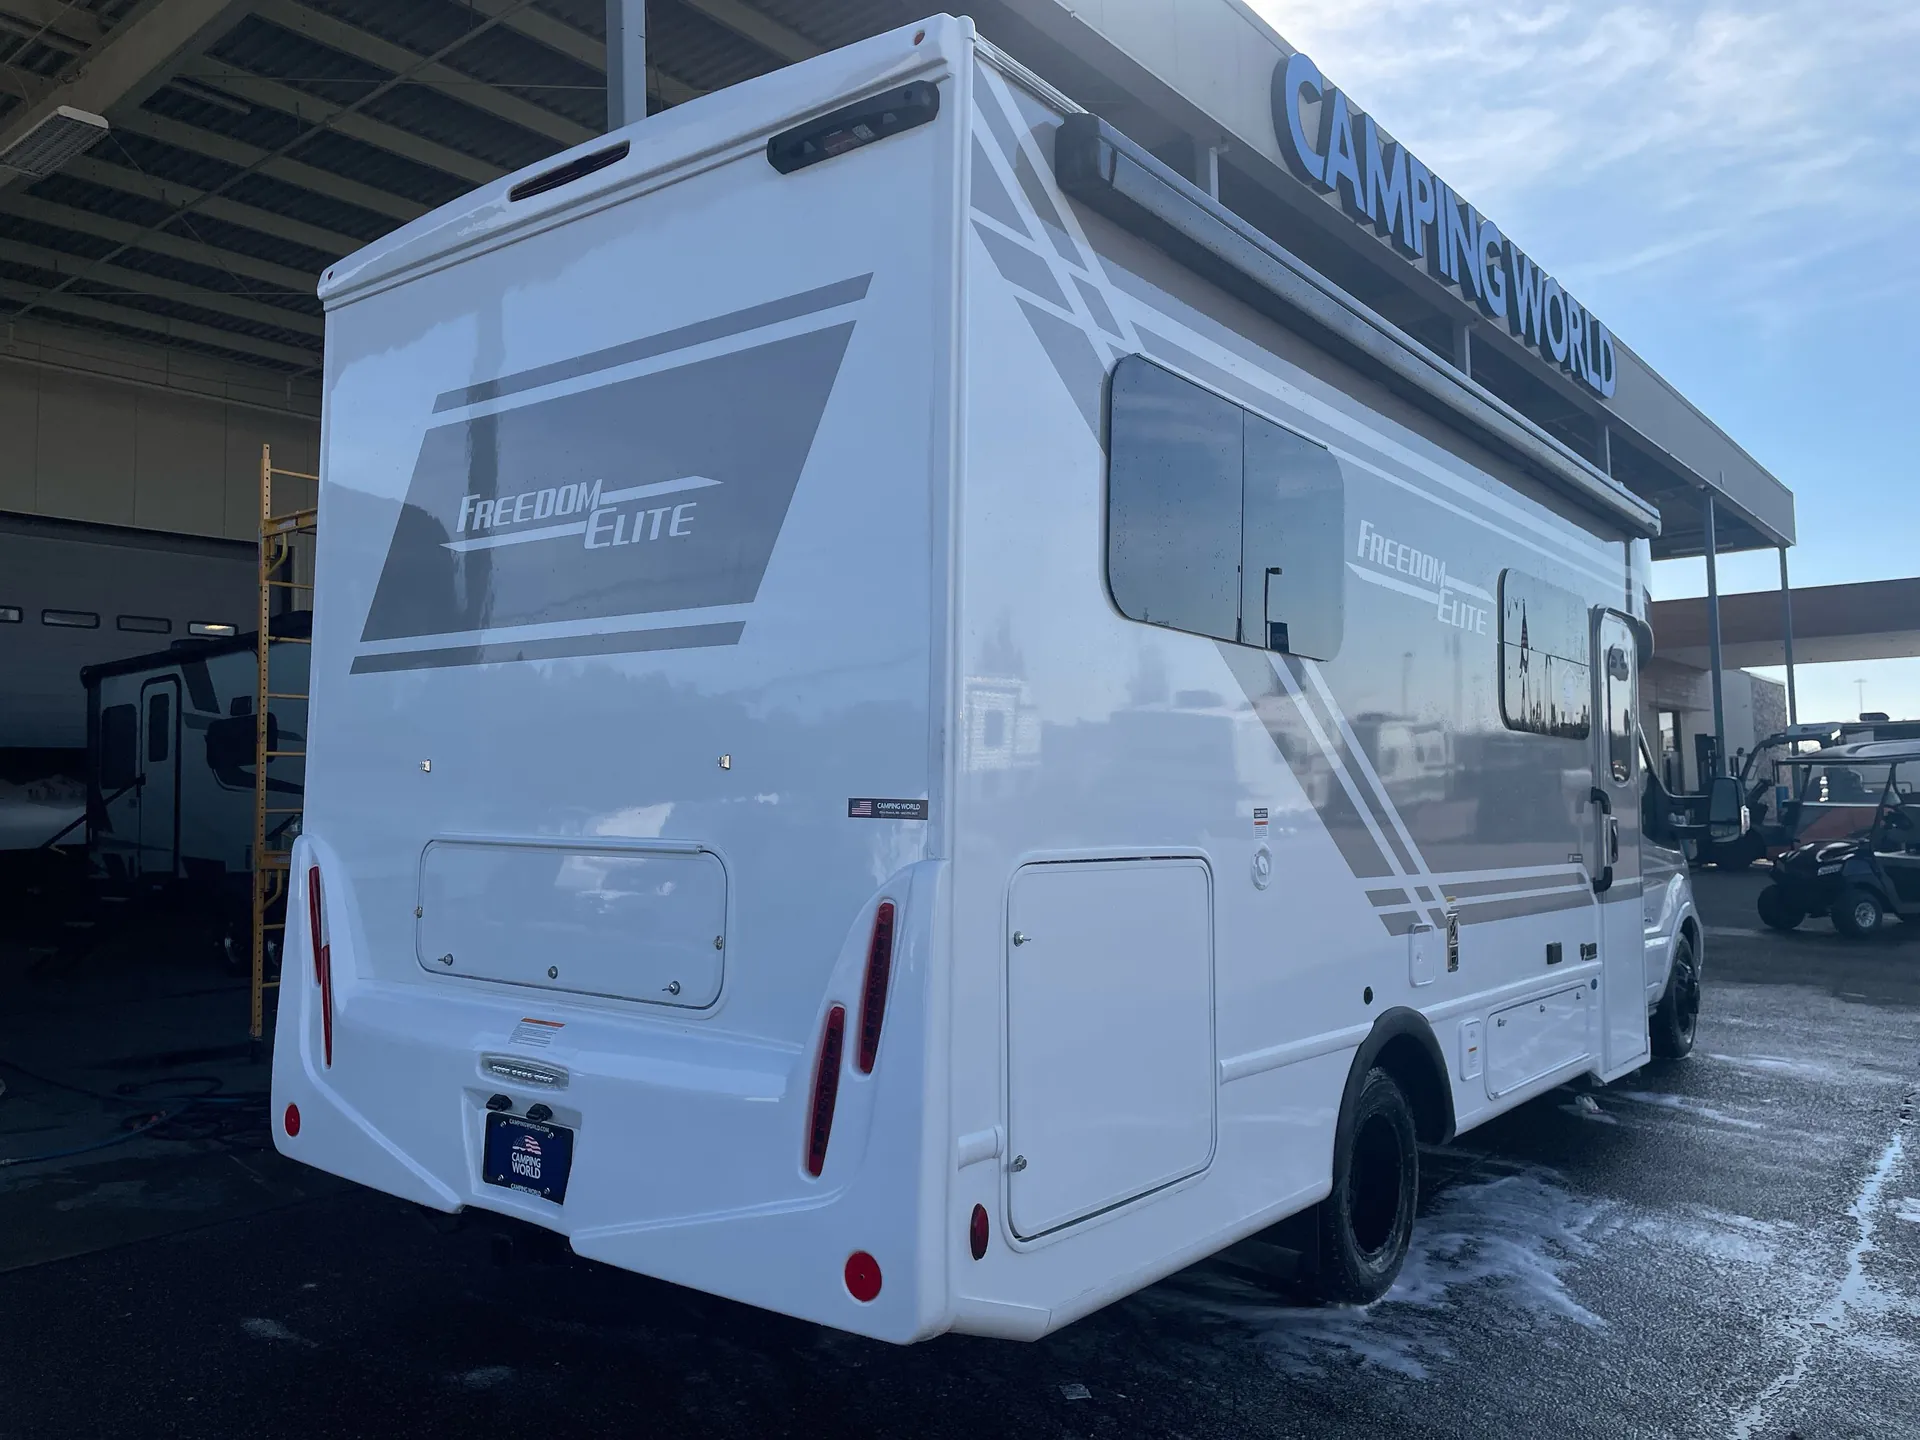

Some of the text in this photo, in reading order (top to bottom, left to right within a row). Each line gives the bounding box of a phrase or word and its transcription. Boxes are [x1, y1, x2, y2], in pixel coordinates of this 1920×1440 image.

[1274, 52, 1617, 400] CAMPING WORLD
[456, 479, 603, 533] FREEDOM
[583, 502, 697, 550] ELITE
[1357, 519, 1446, 588] FREEDOM
[1437, 588, 1487, 636] ELITE
[877, 802, 901, 810] CAMPING
[511, 1152, 541, 1168] CAMPING
[511, 1161, 541, 1179] WORLD
